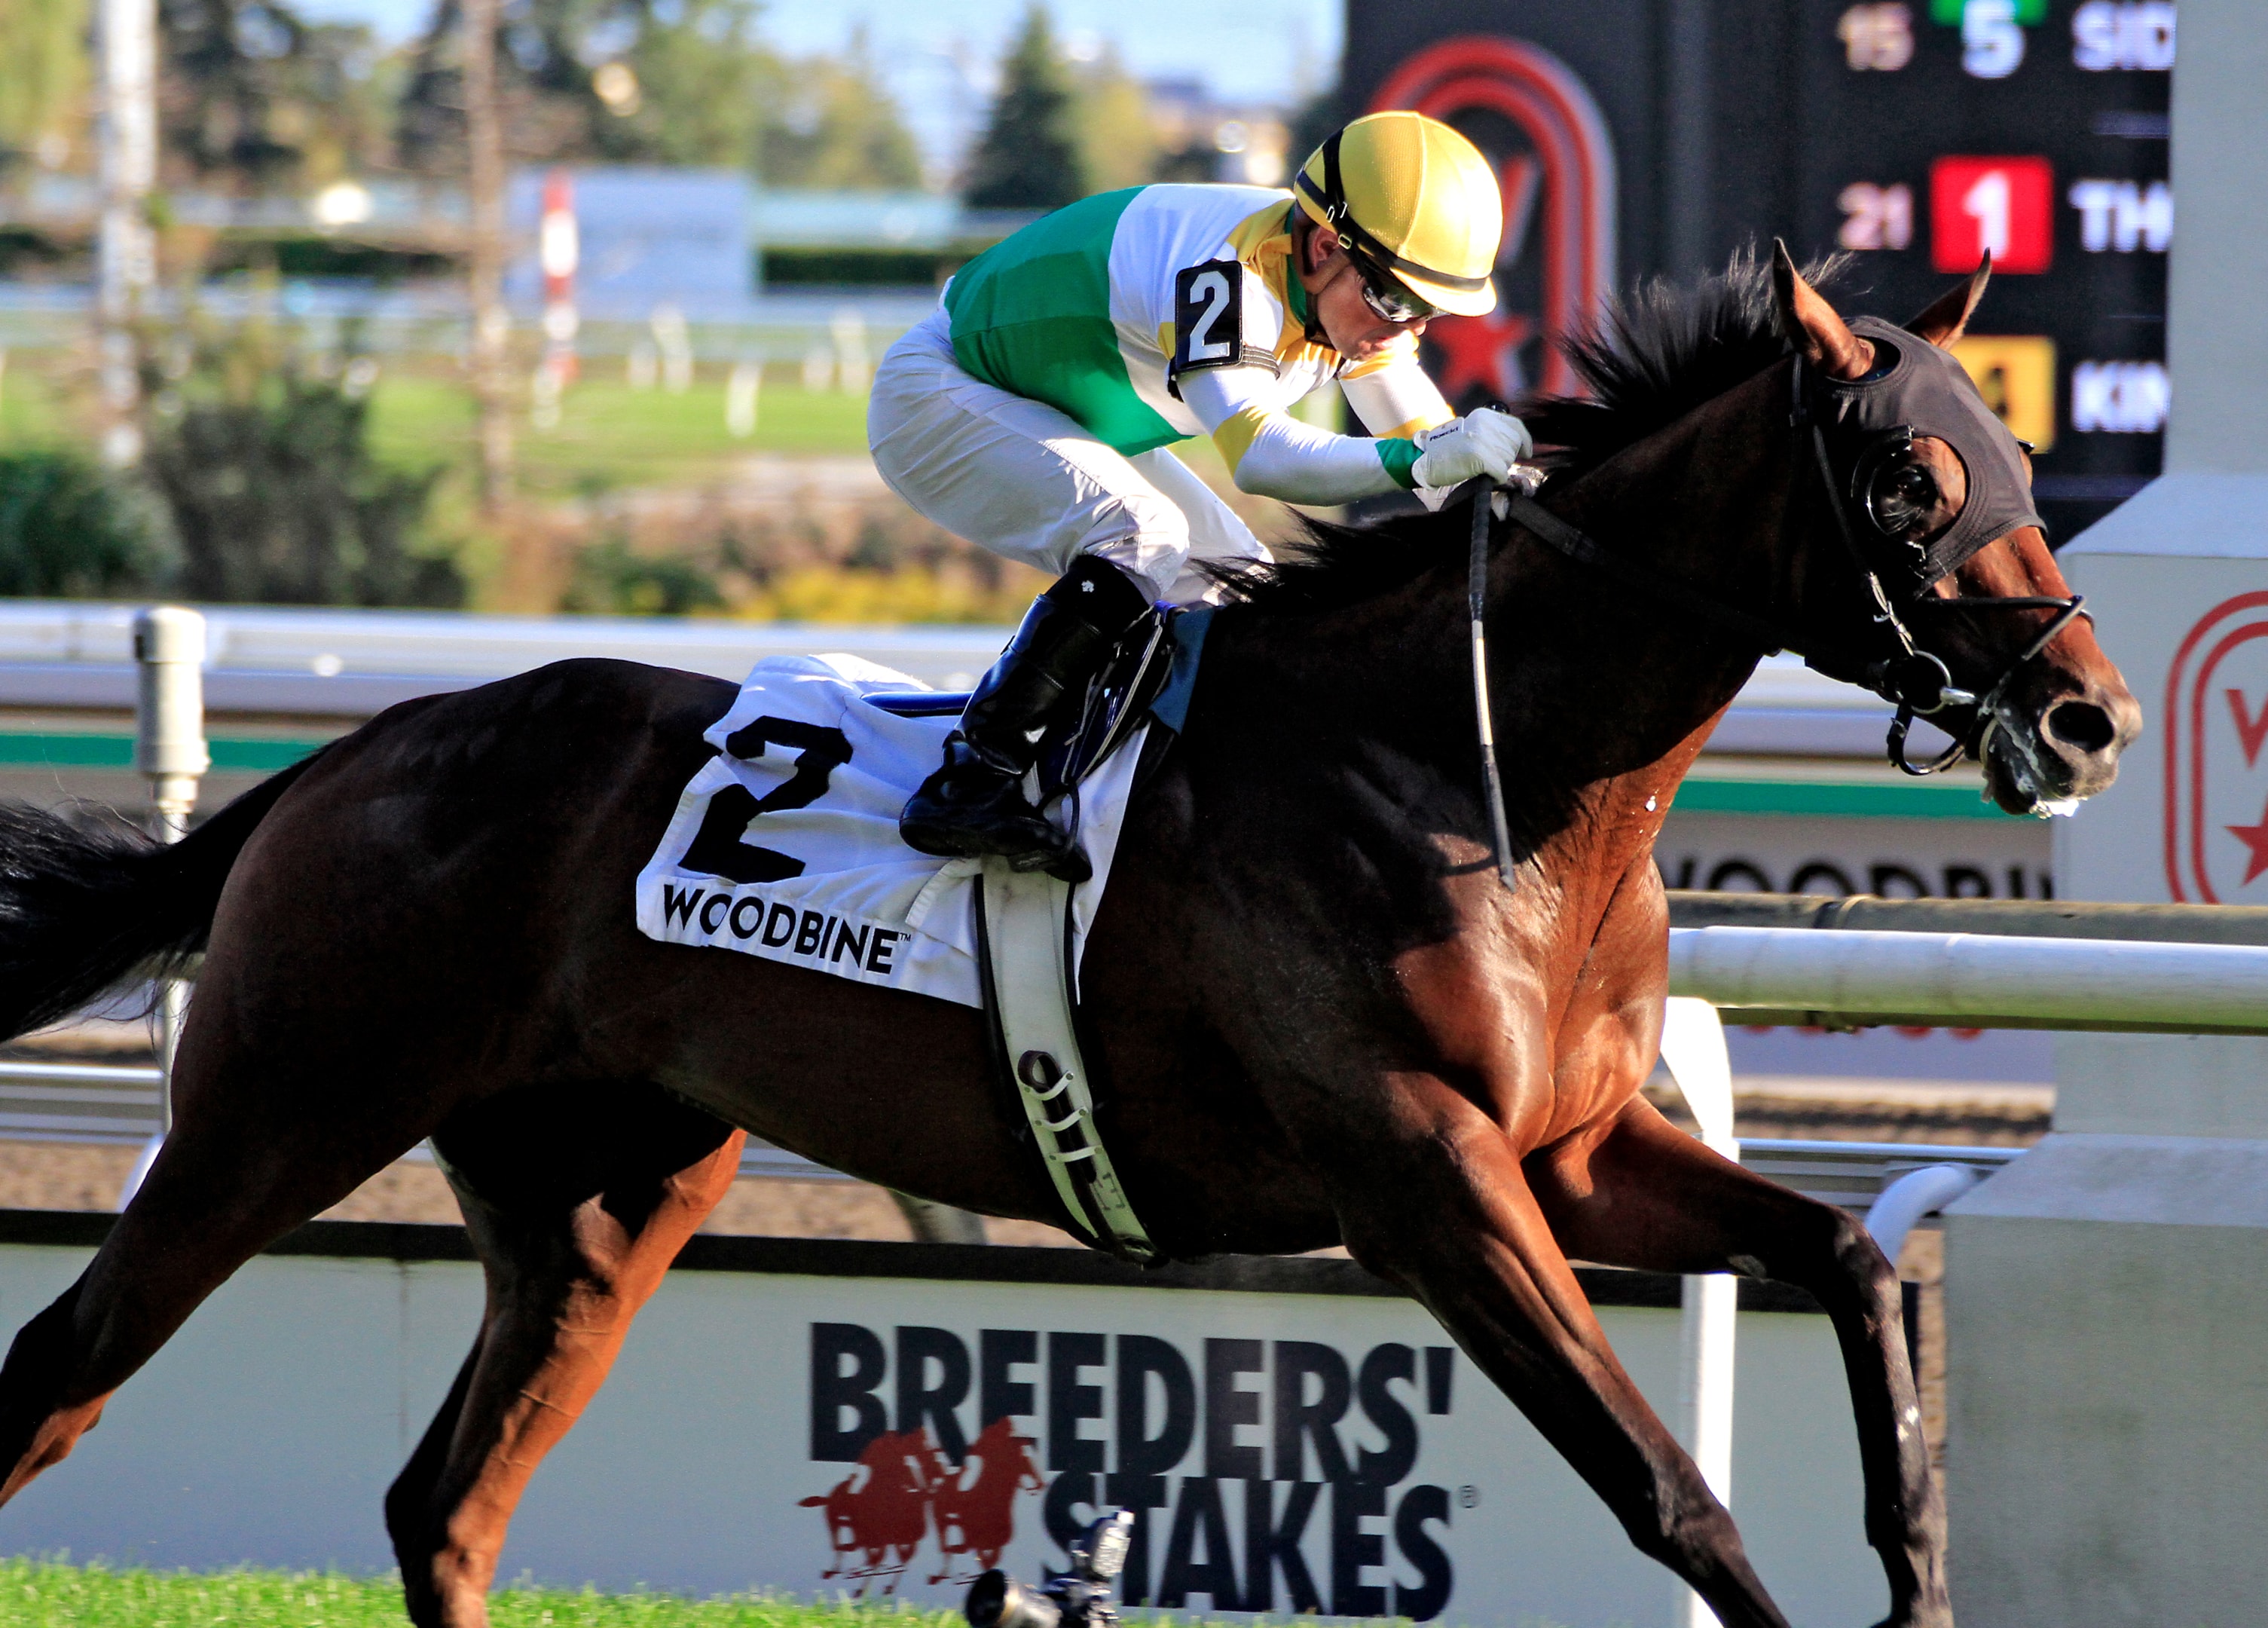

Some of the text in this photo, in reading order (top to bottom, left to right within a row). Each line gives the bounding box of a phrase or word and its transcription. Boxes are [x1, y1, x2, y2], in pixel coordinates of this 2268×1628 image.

[1962, 0, 2025, 78] 5
[1963, 172, 2009, 261] 1
[1189, 271, 1230, 362] 2
[678, 715, 853, 883] 2
[663, 883, 899, 975] WOODBINE
[810, 1323, 1454, 1488] BREEDERS'
[1044, 1473, 1454, 1622] STAKES
